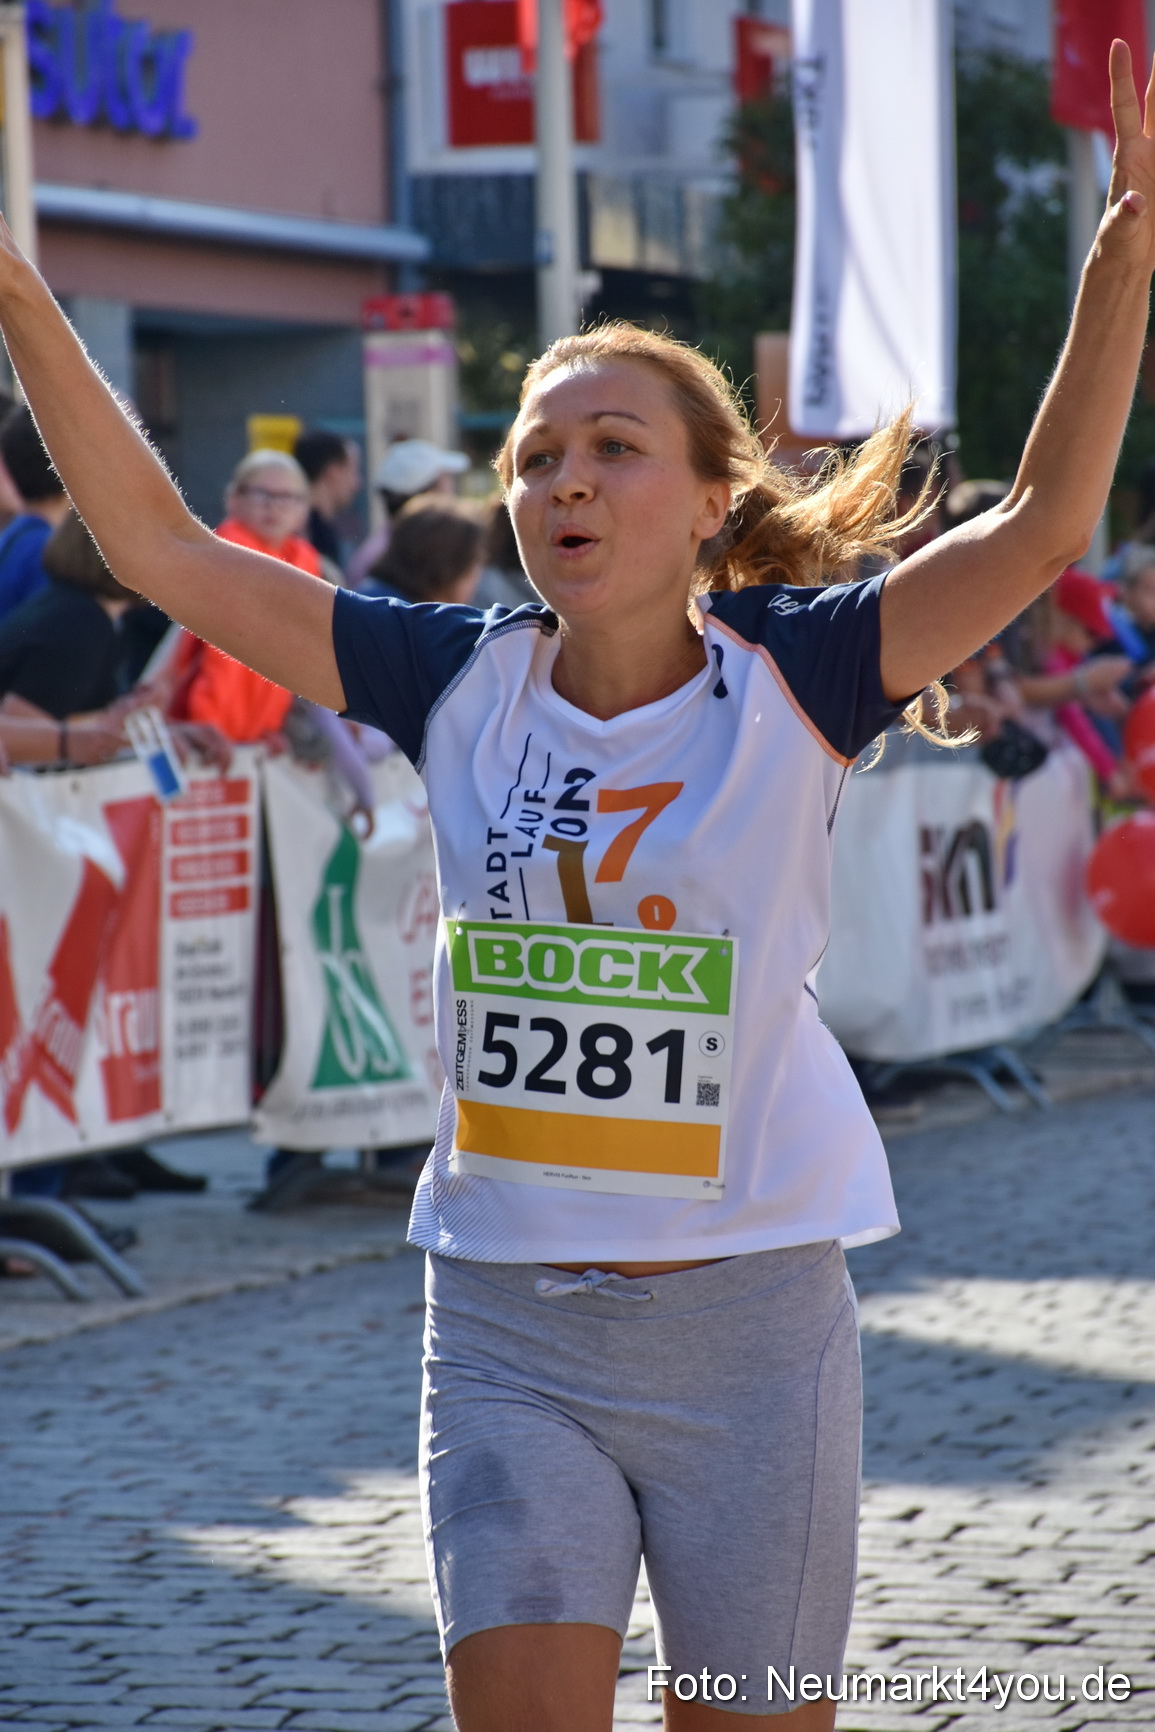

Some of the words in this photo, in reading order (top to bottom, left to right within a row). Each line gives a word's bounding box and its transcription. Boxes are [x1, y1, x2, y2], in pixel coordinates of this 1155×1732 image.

[511, 789, 546, 858] LAUF
[486, 827, 513, 920] TADT
[467, 930, 709, 1004] BOCK
[477, 1011, 685, 1104] 5281
[706, 1036, 718, 1051] S
